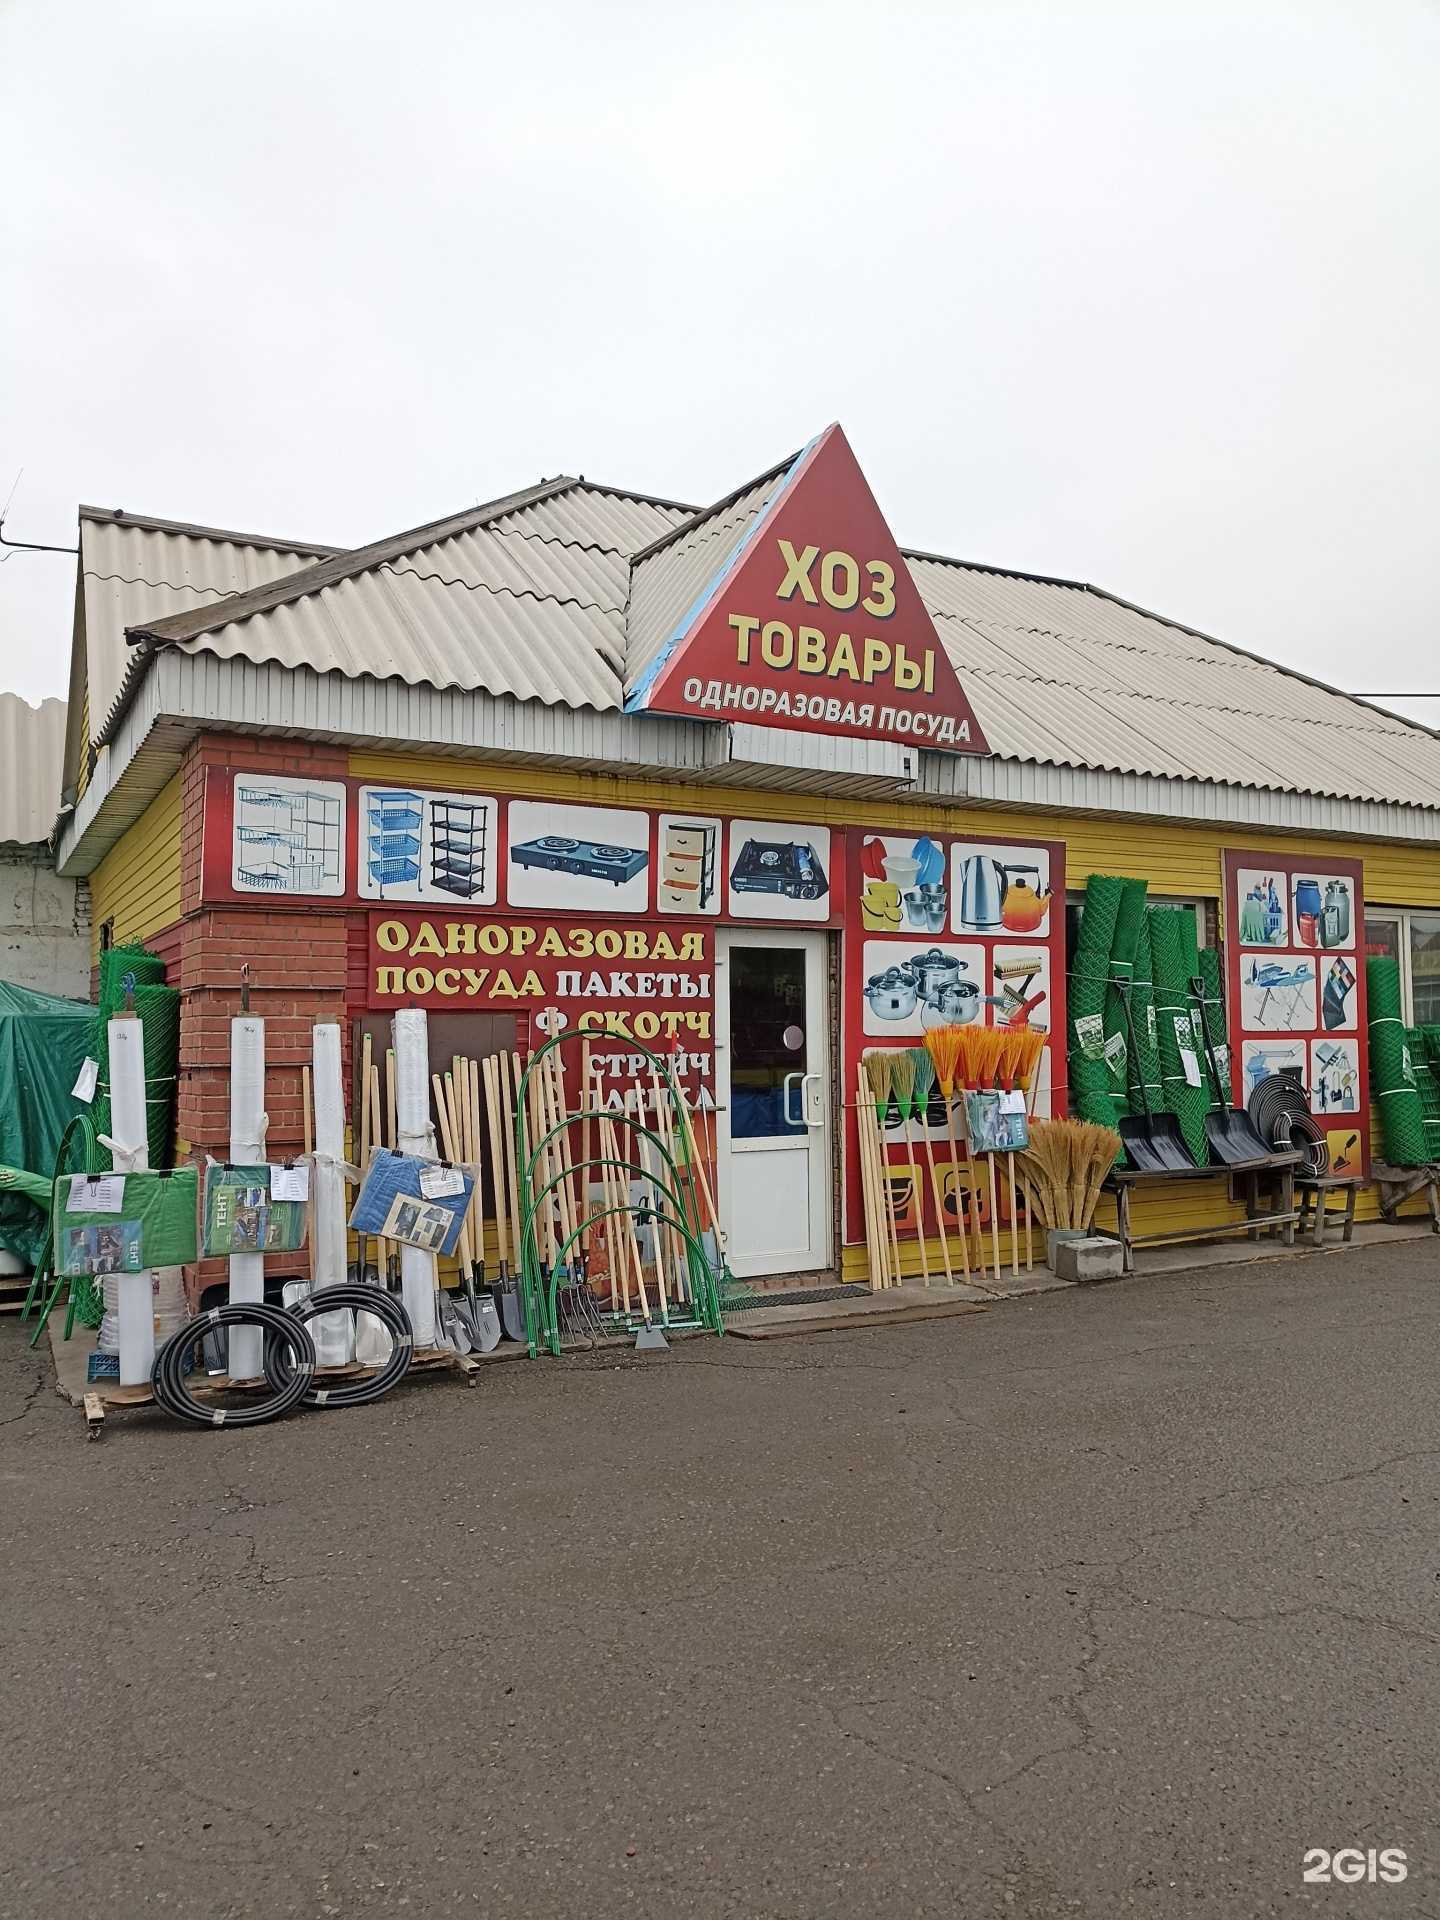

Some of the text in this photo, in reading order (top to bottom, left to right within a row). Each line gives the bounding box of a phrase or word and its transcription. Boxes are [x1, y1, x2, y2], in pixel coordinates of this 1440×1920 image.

[775, 539, 897, 617] ХОЗ
[728, 613, 935, 693] ТОВАРЫ
[683, 678, 972, 743] ОДНОРАЗОВАЯ ПОСУДА
[376, 920, 705, 960] ОДНОРАЗОВАЯ
[375, 966, 711, 999] ПОСУДА ПАКЕТЫ
[577, 1010, 712, 1040] СКОТЧ
[217, 1193, 228, 1228] ТЕНТ
[129, 1239, 139, 1265] ТЕНТ
